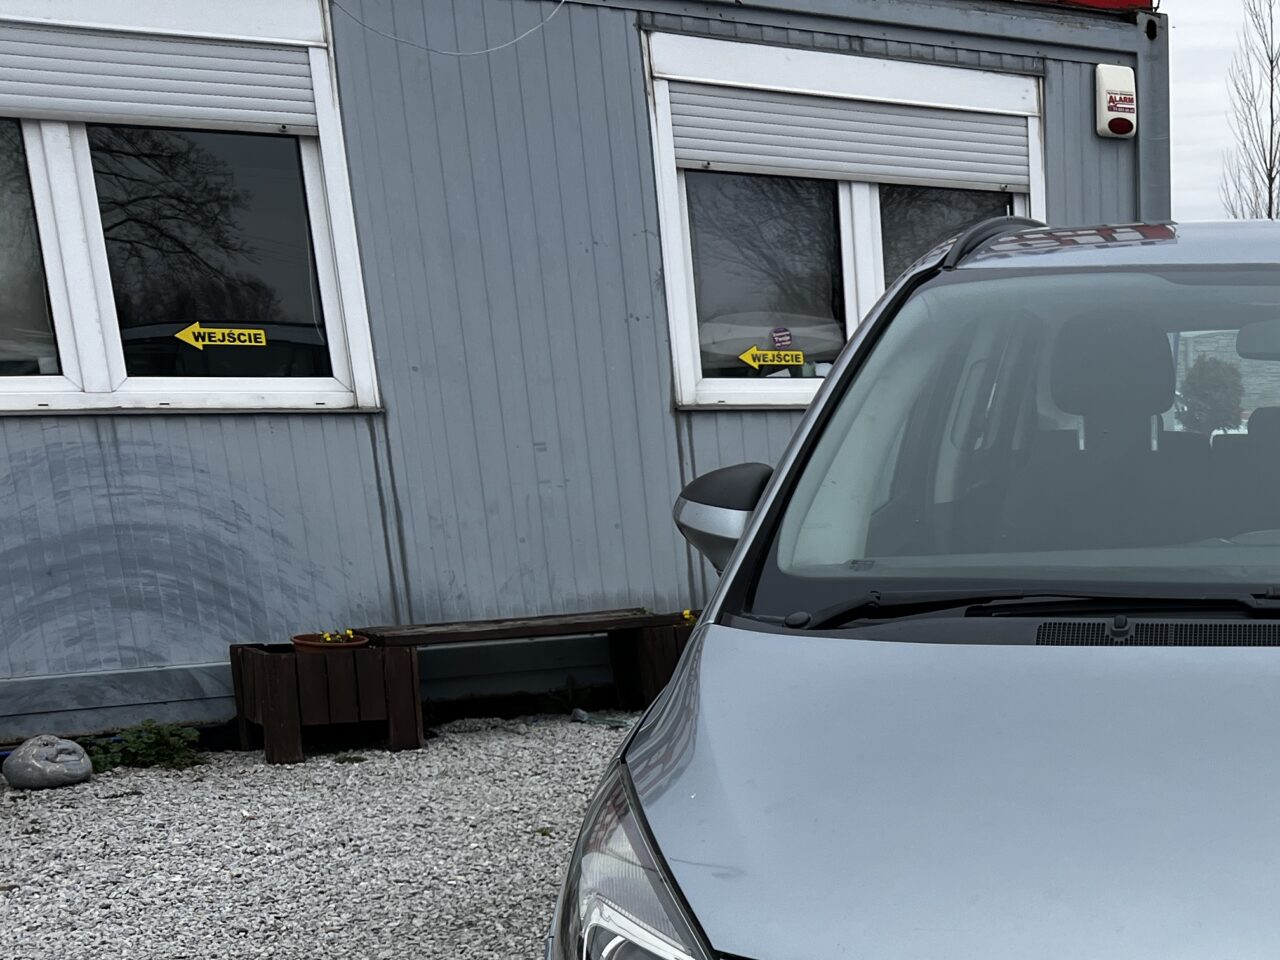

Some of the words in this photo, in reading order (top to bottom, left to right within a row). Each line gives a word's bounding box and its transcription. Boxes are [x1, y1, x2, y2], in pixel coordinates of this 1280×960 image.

[1108, 95, 1134, 104] ALARM
[192, 329, 263, 344] WEJŚCIE
[751, 351, 802, 363] WEJŚCIE
